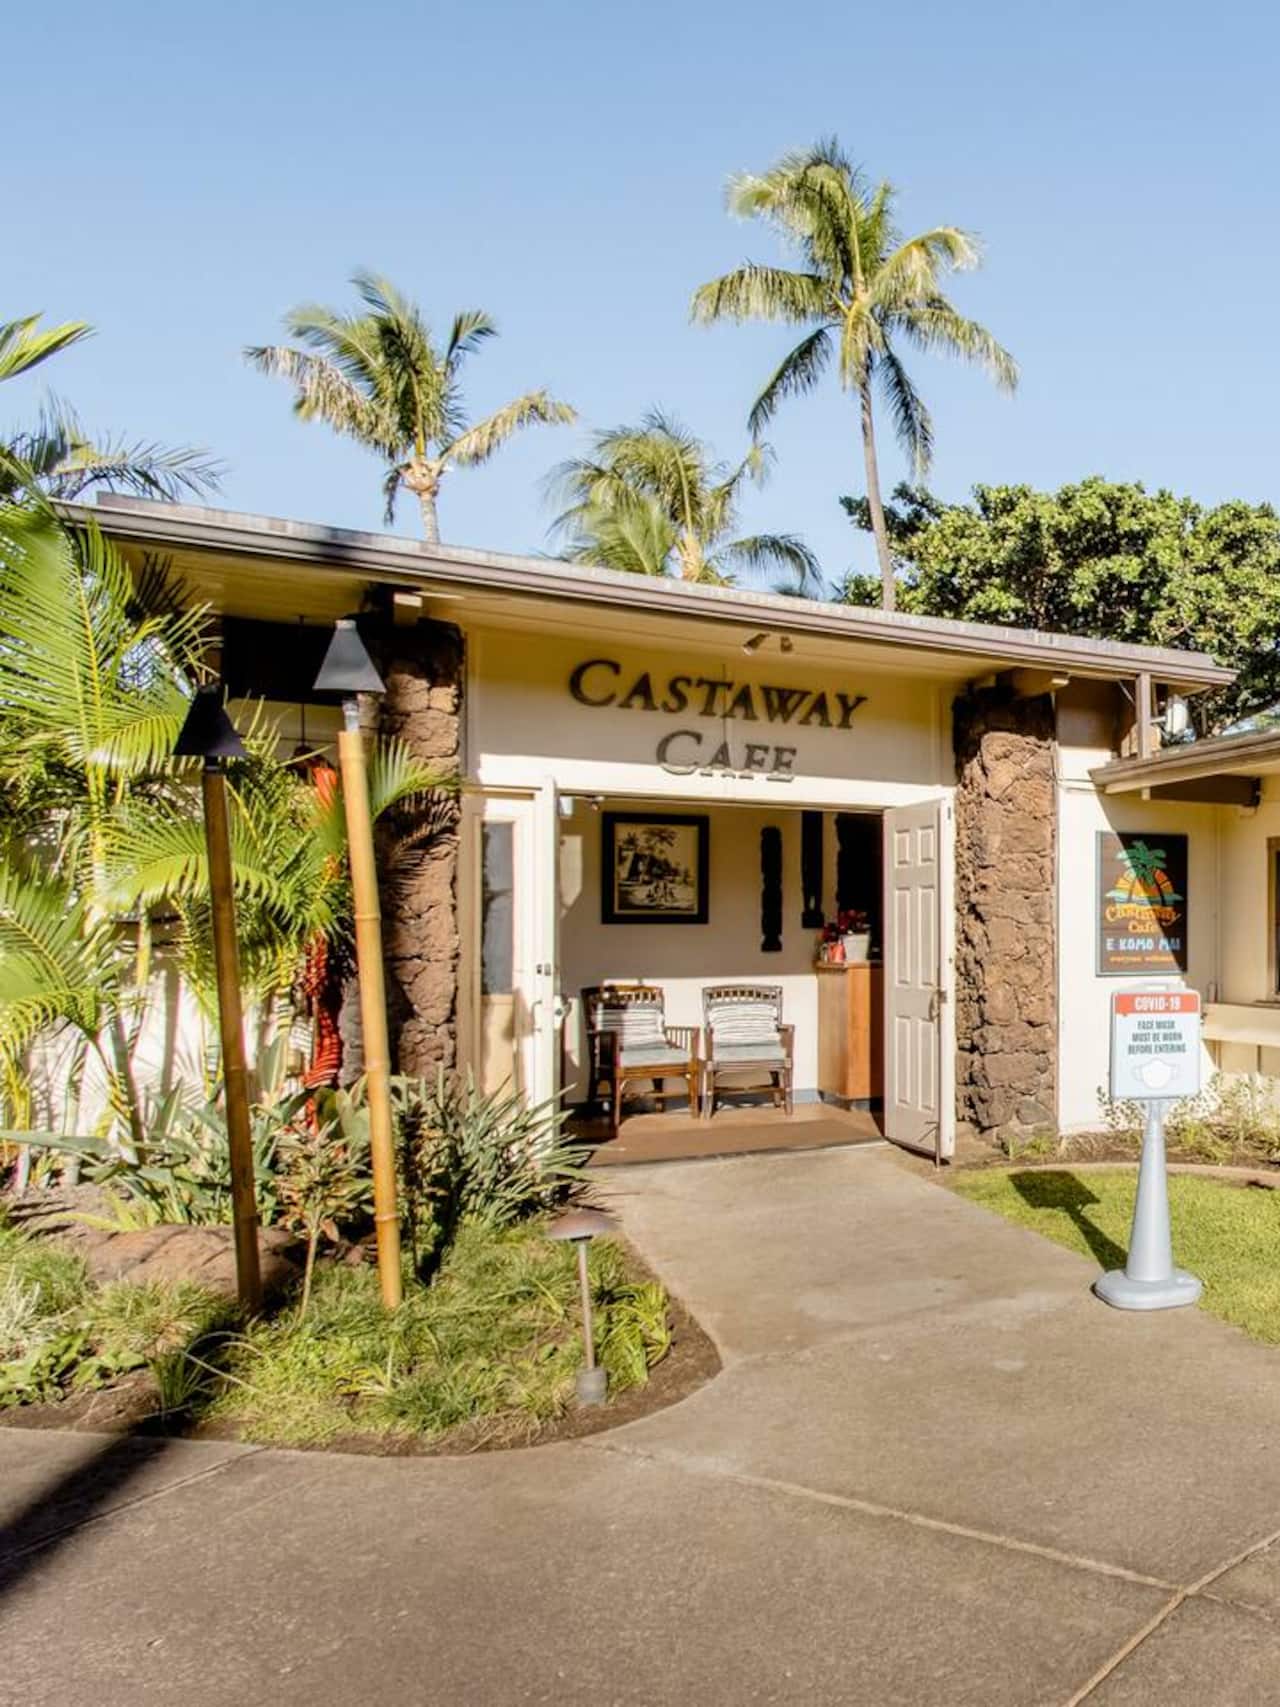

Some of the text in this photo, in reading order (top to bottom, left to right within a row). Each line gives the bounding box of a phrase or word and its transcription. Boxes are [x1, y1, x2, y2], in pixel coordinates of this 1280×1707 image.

[569, 658, 869, 729] CASTAWAY
[656, 729, 797, 783] CAFE
[1106, 937, 1115, 951] E
[1119, 937, 1154, 951] KOMO
[1135, 996, 1181, 1011] COVID-19
[1137, 1020, 1154, 1030] FACE
[1132, 1032, 1183, 1042] MUST BE WORN
[1128, 1043, 1186, 1055] BEFORE ENTERING
